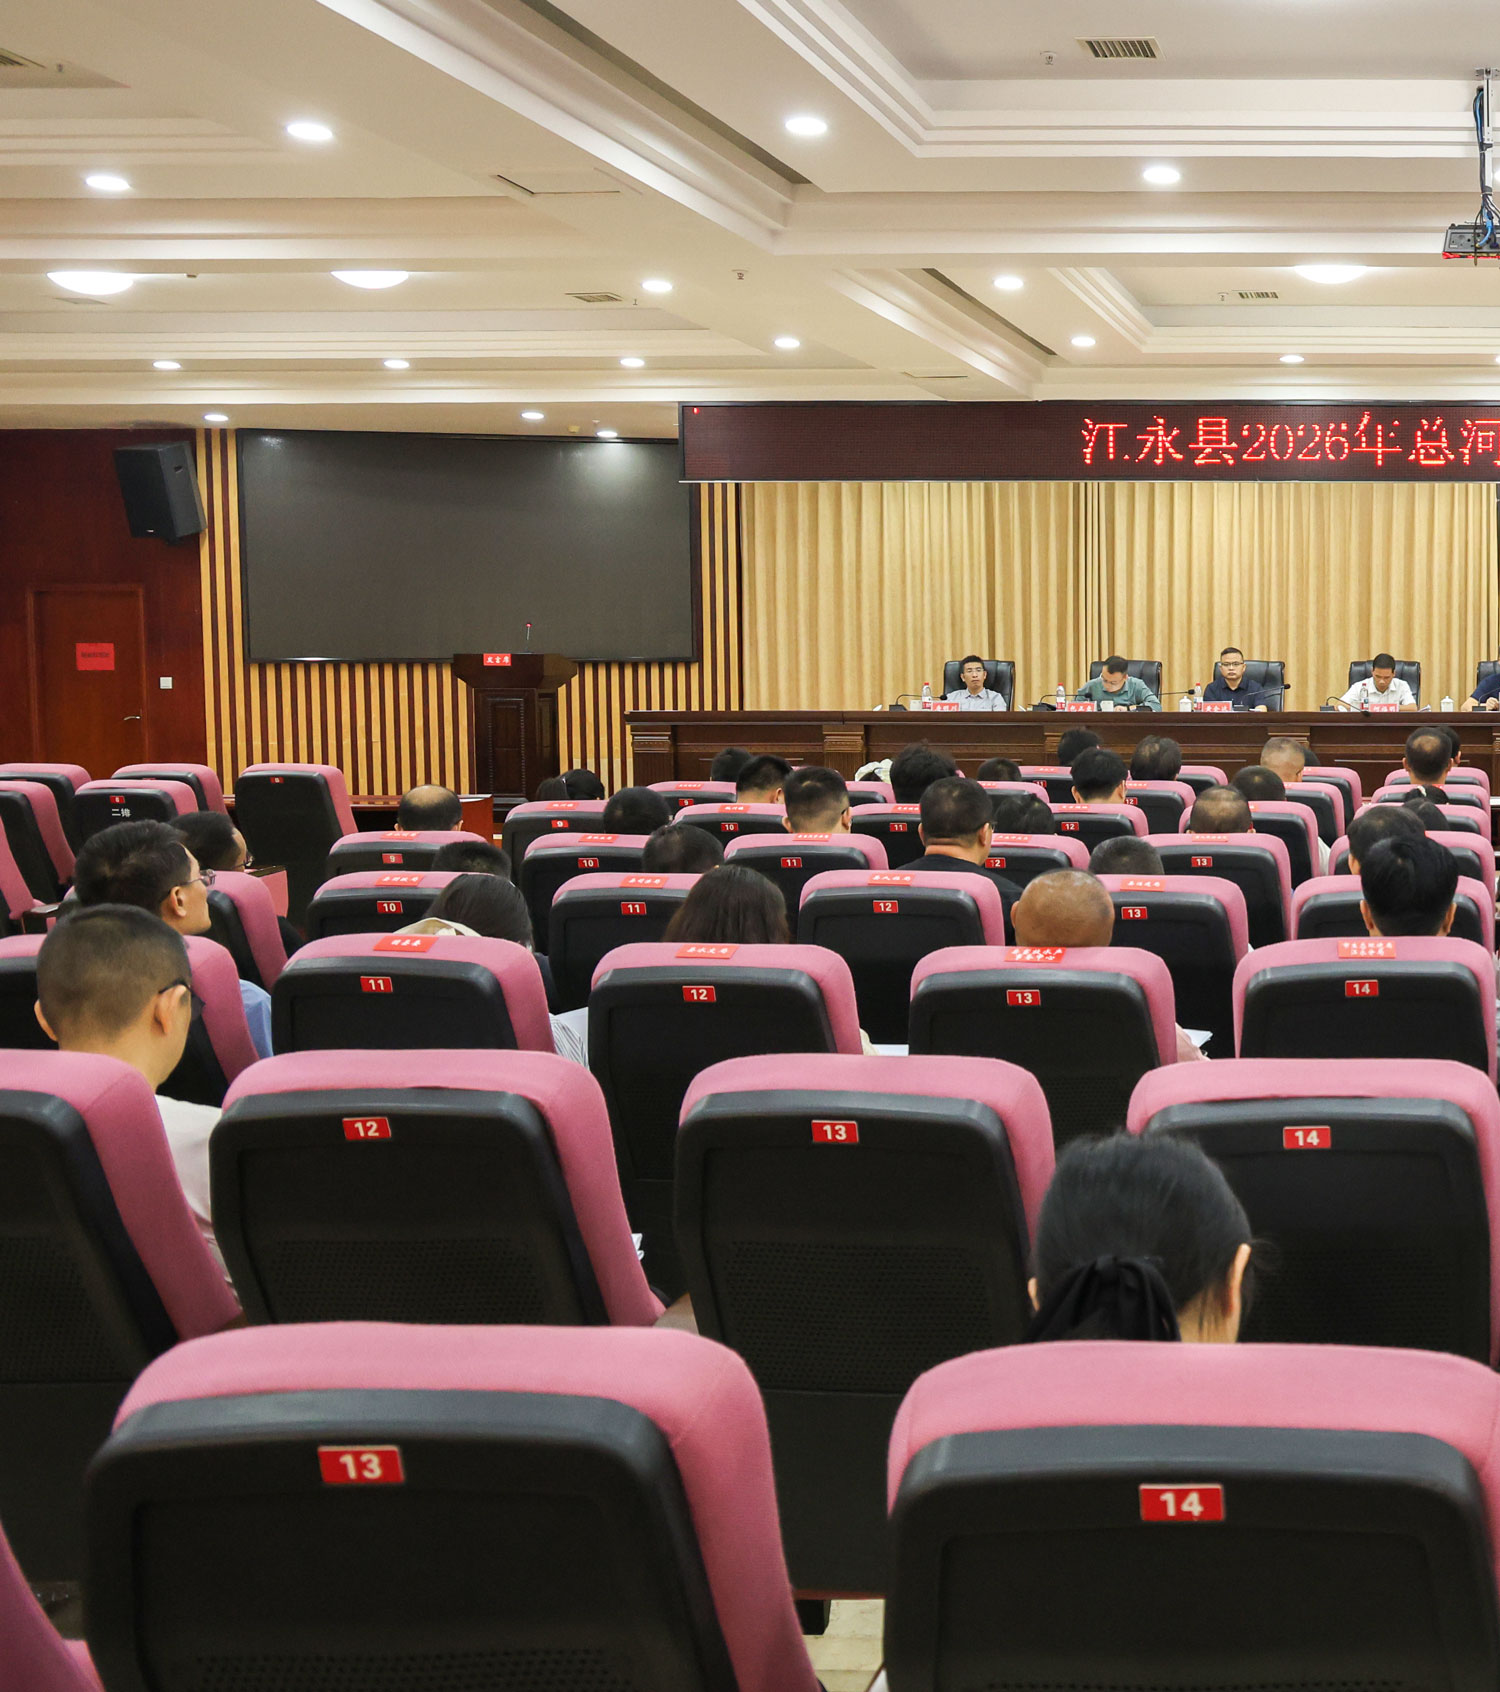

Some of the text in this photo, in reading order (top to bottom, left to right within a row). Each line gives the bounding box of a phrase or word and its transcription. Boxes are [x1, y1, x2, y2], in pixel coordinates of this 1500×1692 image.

[112, 808, 131, 817] 二排
[384, 903, 396, 911] 10
[880, 903, 891, 911] 12
[1128, 909, 1140, 917] 13
[369, 980, 384, 990] 11
[1354, 984, 1370, 994] 14
[691, 989, 707, 1000] 12
[1016, 993, 1033, 1003] 13
[355, 1122, 378, 1136] 12
[824, 1125, 846, 1140] 13
[1295, 1130, 1319, 1146] 14
[340, 1454, 382, 1478] 13
[1161, 1492, 1203, 1516] 14
